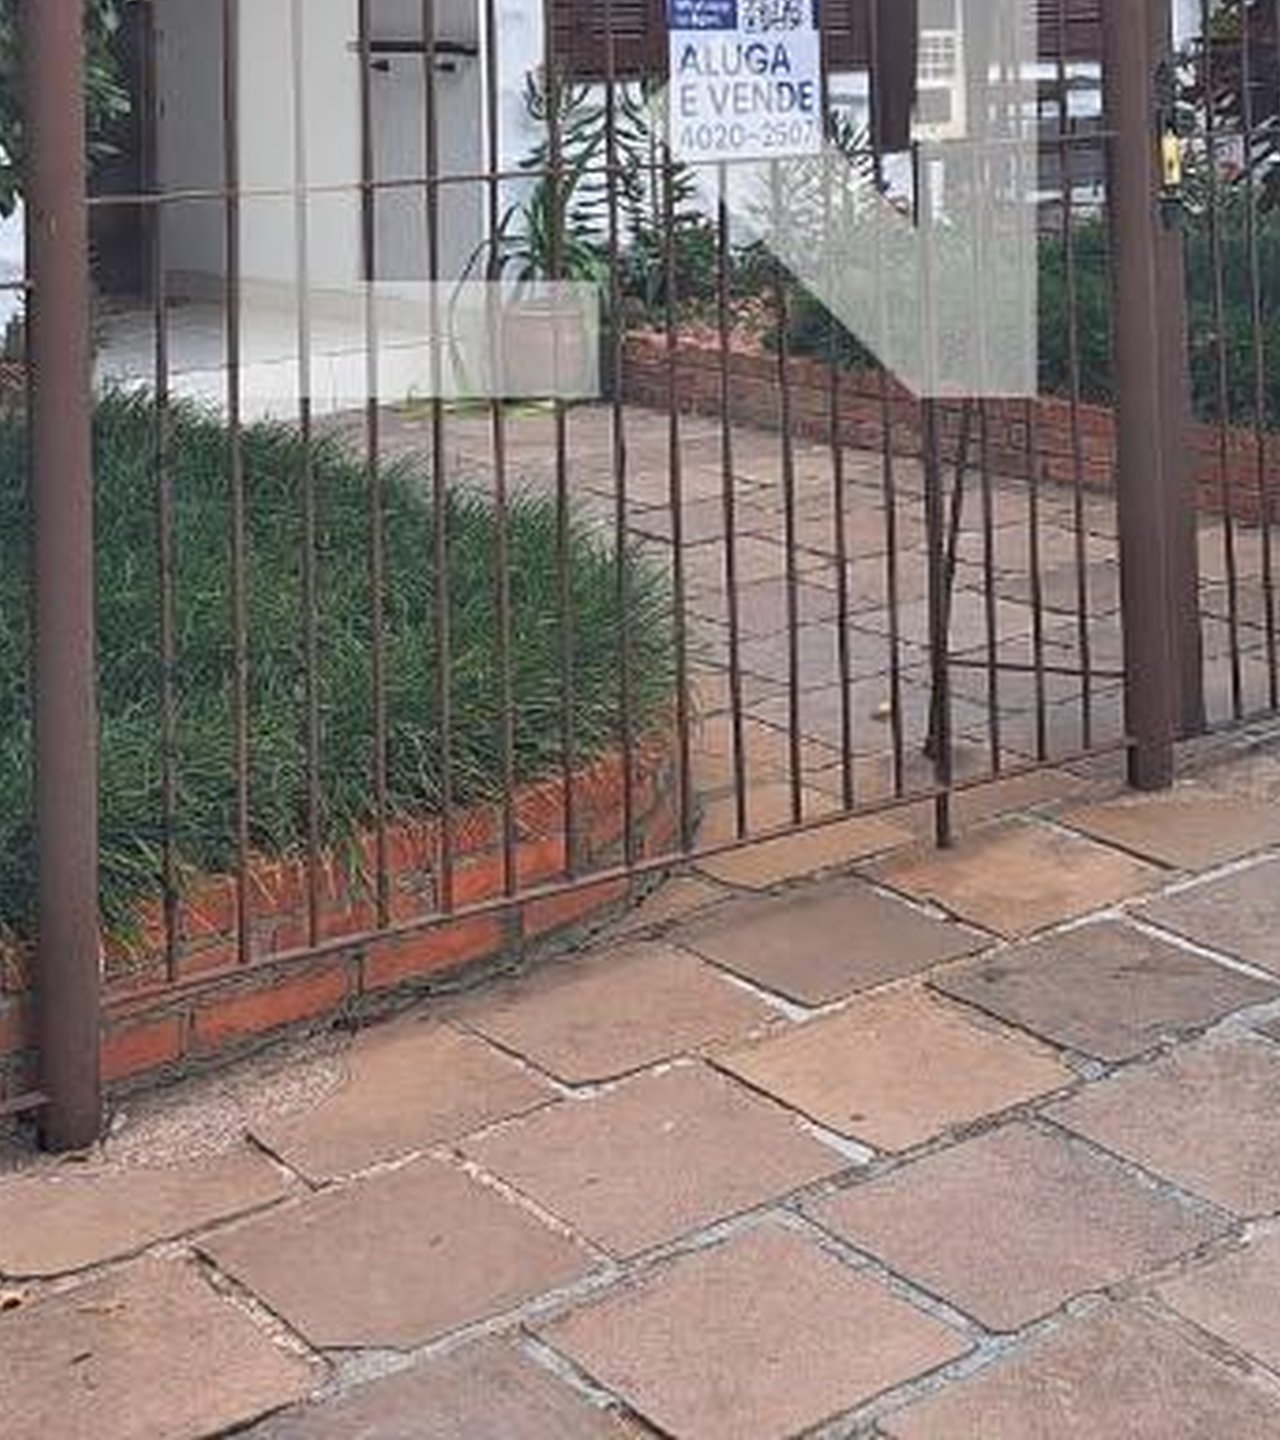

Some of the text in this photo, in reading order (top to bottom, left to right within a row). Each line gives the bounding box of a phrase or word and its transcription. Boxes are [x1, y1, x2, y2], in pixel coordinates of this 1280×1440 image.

[680, 42, 791, 76] ALUGA
[681, 80, 814, 117] E VENDE
